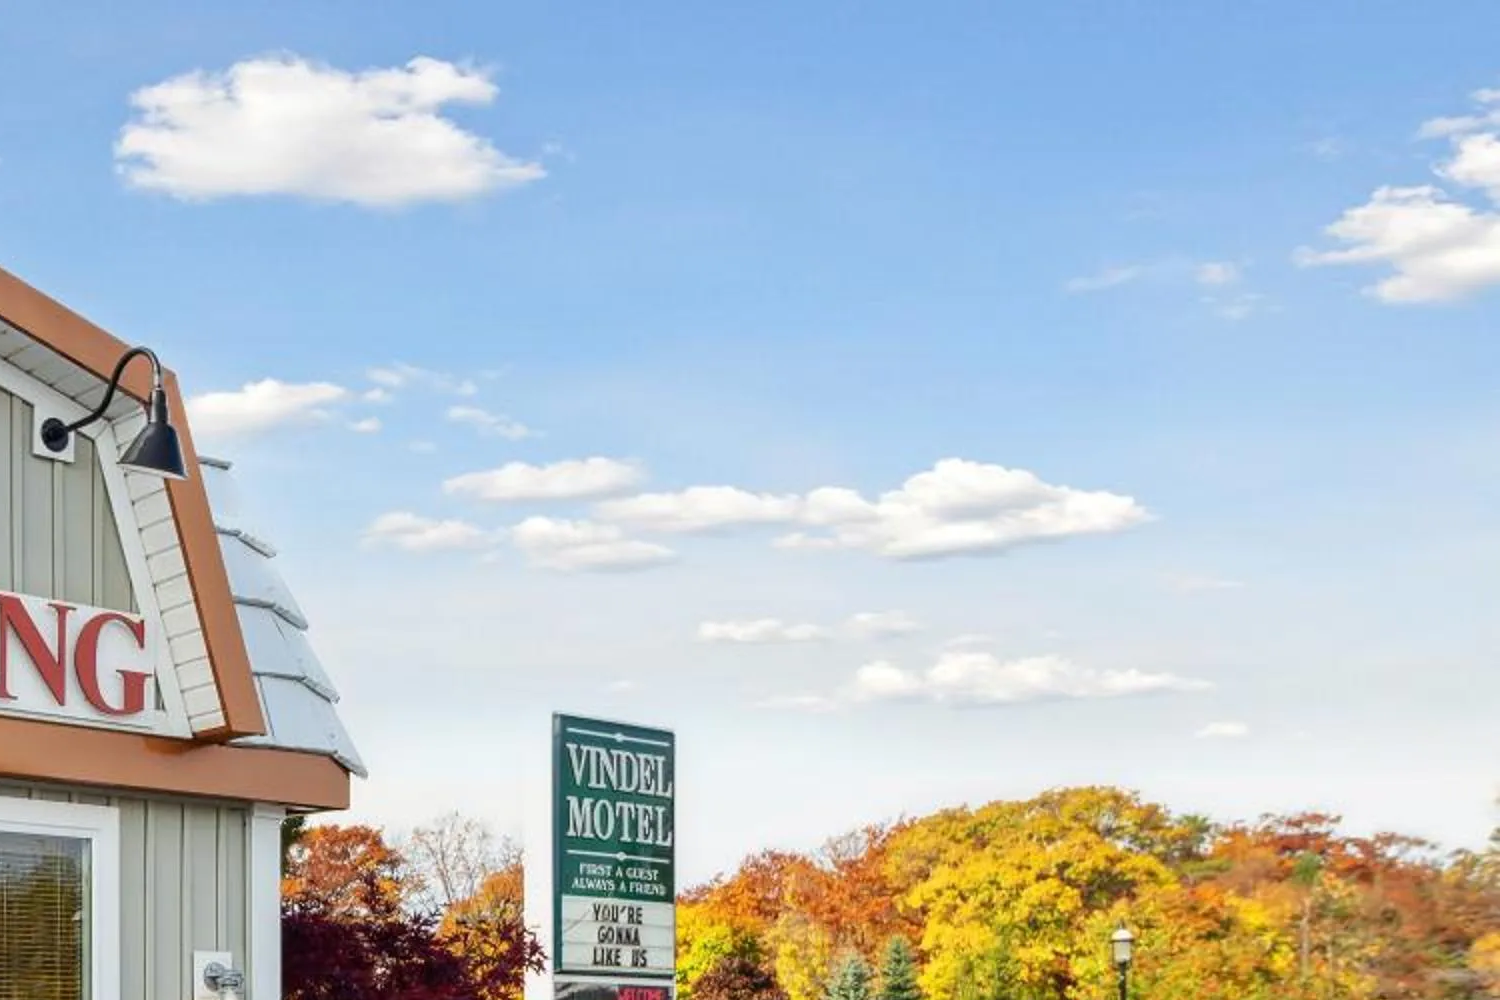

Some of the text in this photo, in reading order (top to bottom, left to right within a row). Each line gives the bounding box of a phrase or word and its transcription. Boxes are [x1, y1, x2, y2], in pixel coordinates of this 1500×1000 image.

[566, 742, 673, 798] VINDEL
[566, 795, 673, 848] MOTEL
[579, 862, 659, 881] FIRST A GUEST
[571, 877, 667, 897] ALWAYS A FRIEND
[593, 903, 643, 925] YOU'RE
[597, 925, 641, 946] GONNA
[592, 946, 648, 968] LIKE US
